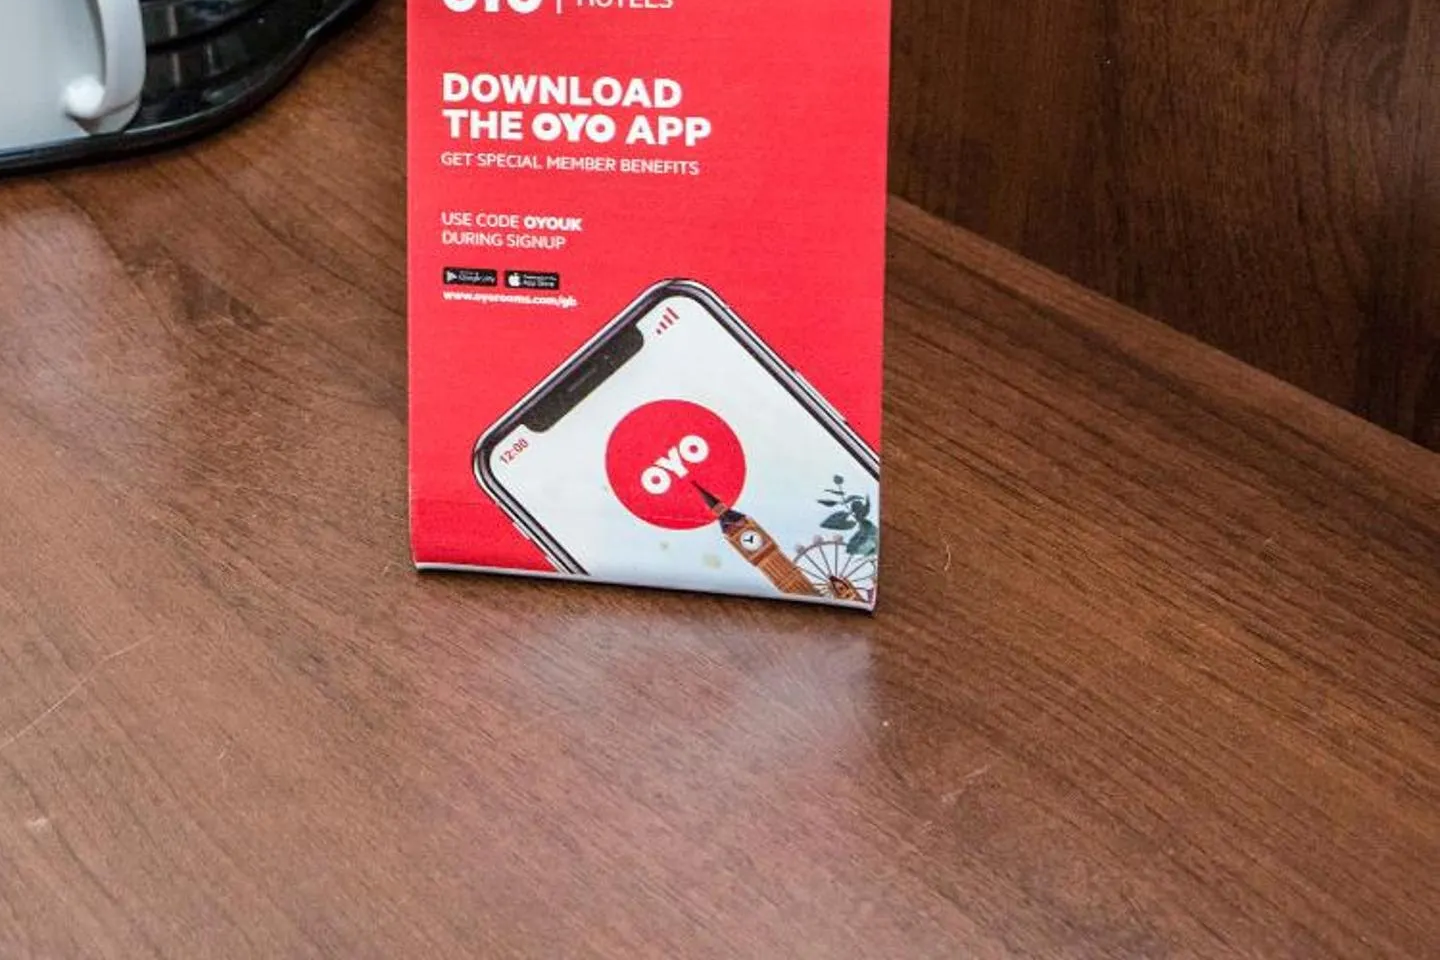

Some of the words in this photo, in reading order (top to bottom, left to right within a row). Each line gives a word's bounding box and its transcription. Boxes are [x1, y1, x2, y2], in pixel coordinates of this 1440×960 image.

[443, 73, 682, 108] DOWNLOAD
[442, 109, 523, 140] THE
[532, 113, 616, 143] OYO
[625, 115, 711, 146] APP
[441, 152, 473, 165] GET
[477, 153, 541, 168] SPECIAL
[547, 156, 616, 171] MEMBER
[620, 159, 699, 175] BENEFITS
[442, 212, 472, 226] USE
[476, 213, 519, 228] CODE
[524, 216, 582, 231] OYOUK
[442, 230, 503, 246] DURING
[507, 234, 565, 249] SIGNUP
[498, 438, 530, 466] 12:00
[640, 434, 710, 495] OYO
